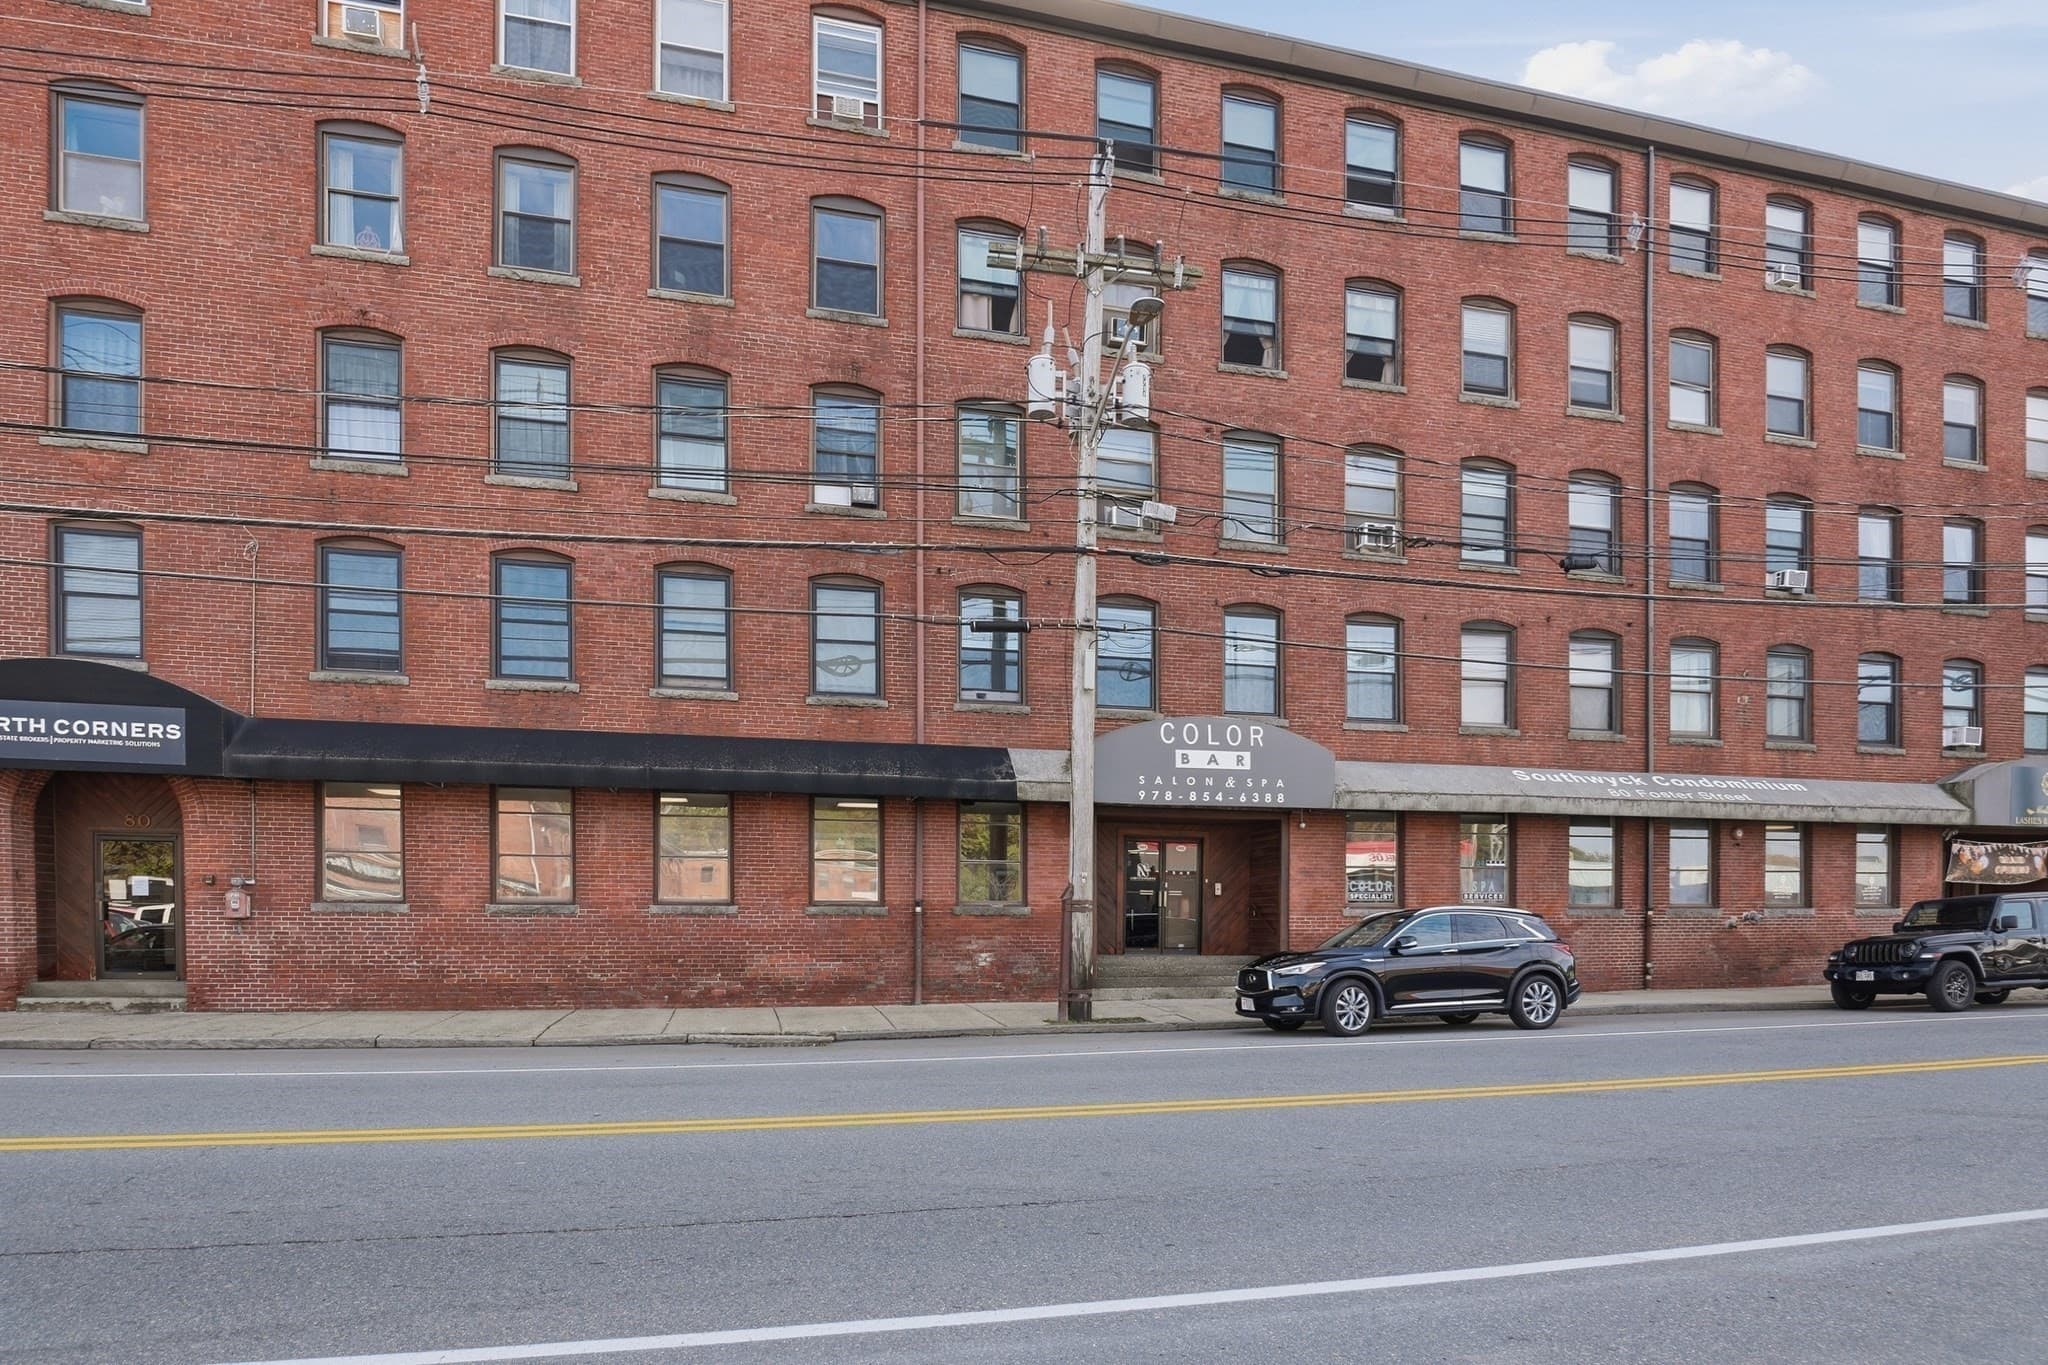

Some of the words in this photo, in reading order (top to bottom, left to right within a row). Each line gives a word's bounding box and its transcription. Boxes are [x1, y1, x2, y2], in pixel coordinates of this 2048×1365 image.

[0, 716, 46, 733] RTH
[53, 719, 181, 739] CORNERS
[1160, 722, 1264, 747] COLOR
[124, 740, 161, 748] SOLUTIONS
[1181, 753, 1245, 767] BAR
[1138, 775, 1213, 787] SALON
[1225, 776, 1236, 788] &
[1246, 778, 1285, 788] SPA
[1511, 769, 1648, 787] Southwyck
[1652, 775, 1808, 792] Condominium
[1138, 790, 1285, 803] 978-854-6388
[1635, 789, 1694, 800] Foster
[1697, 791, 1753, 801] Street
[1349, 880, 1393, 892] COLOR
[1471, 880, 1495, 892] SPA
